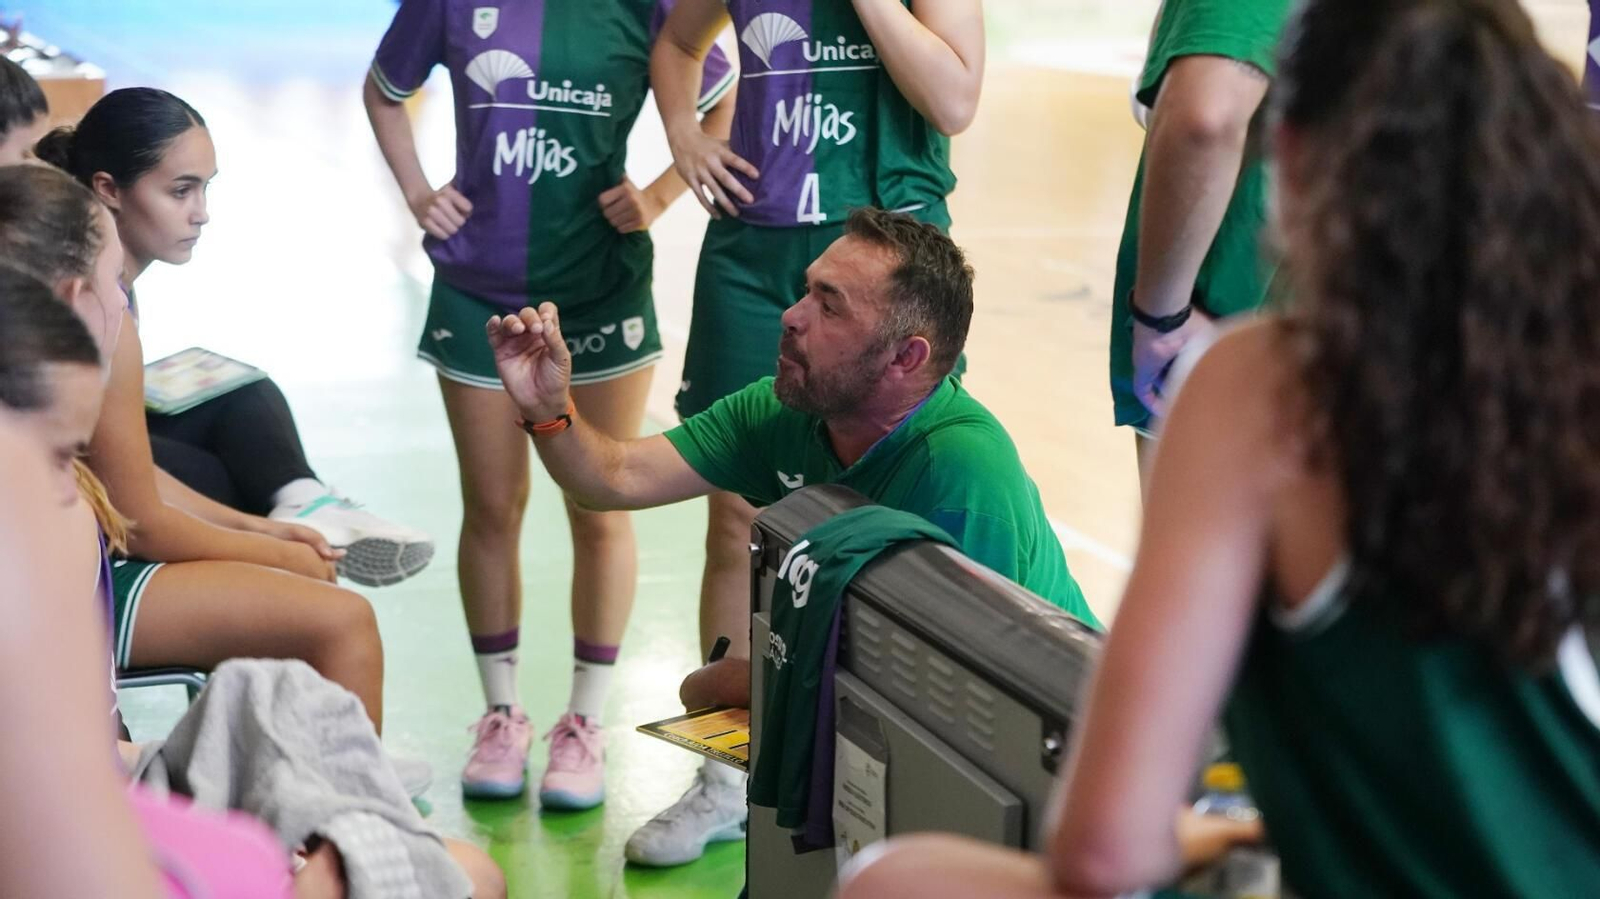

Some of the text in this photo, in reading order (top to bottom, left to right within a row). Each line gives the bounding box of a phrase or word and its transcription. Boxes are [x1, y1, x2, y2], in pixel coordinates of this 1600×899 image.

[803, 36, 876, 62] Unica
[527, 79, 613, 111] Unicaja
[772, 92, 857, 155] Mijas
[493, 127, 578, 185] Mijas
[796, 173, 827, 226] 4
